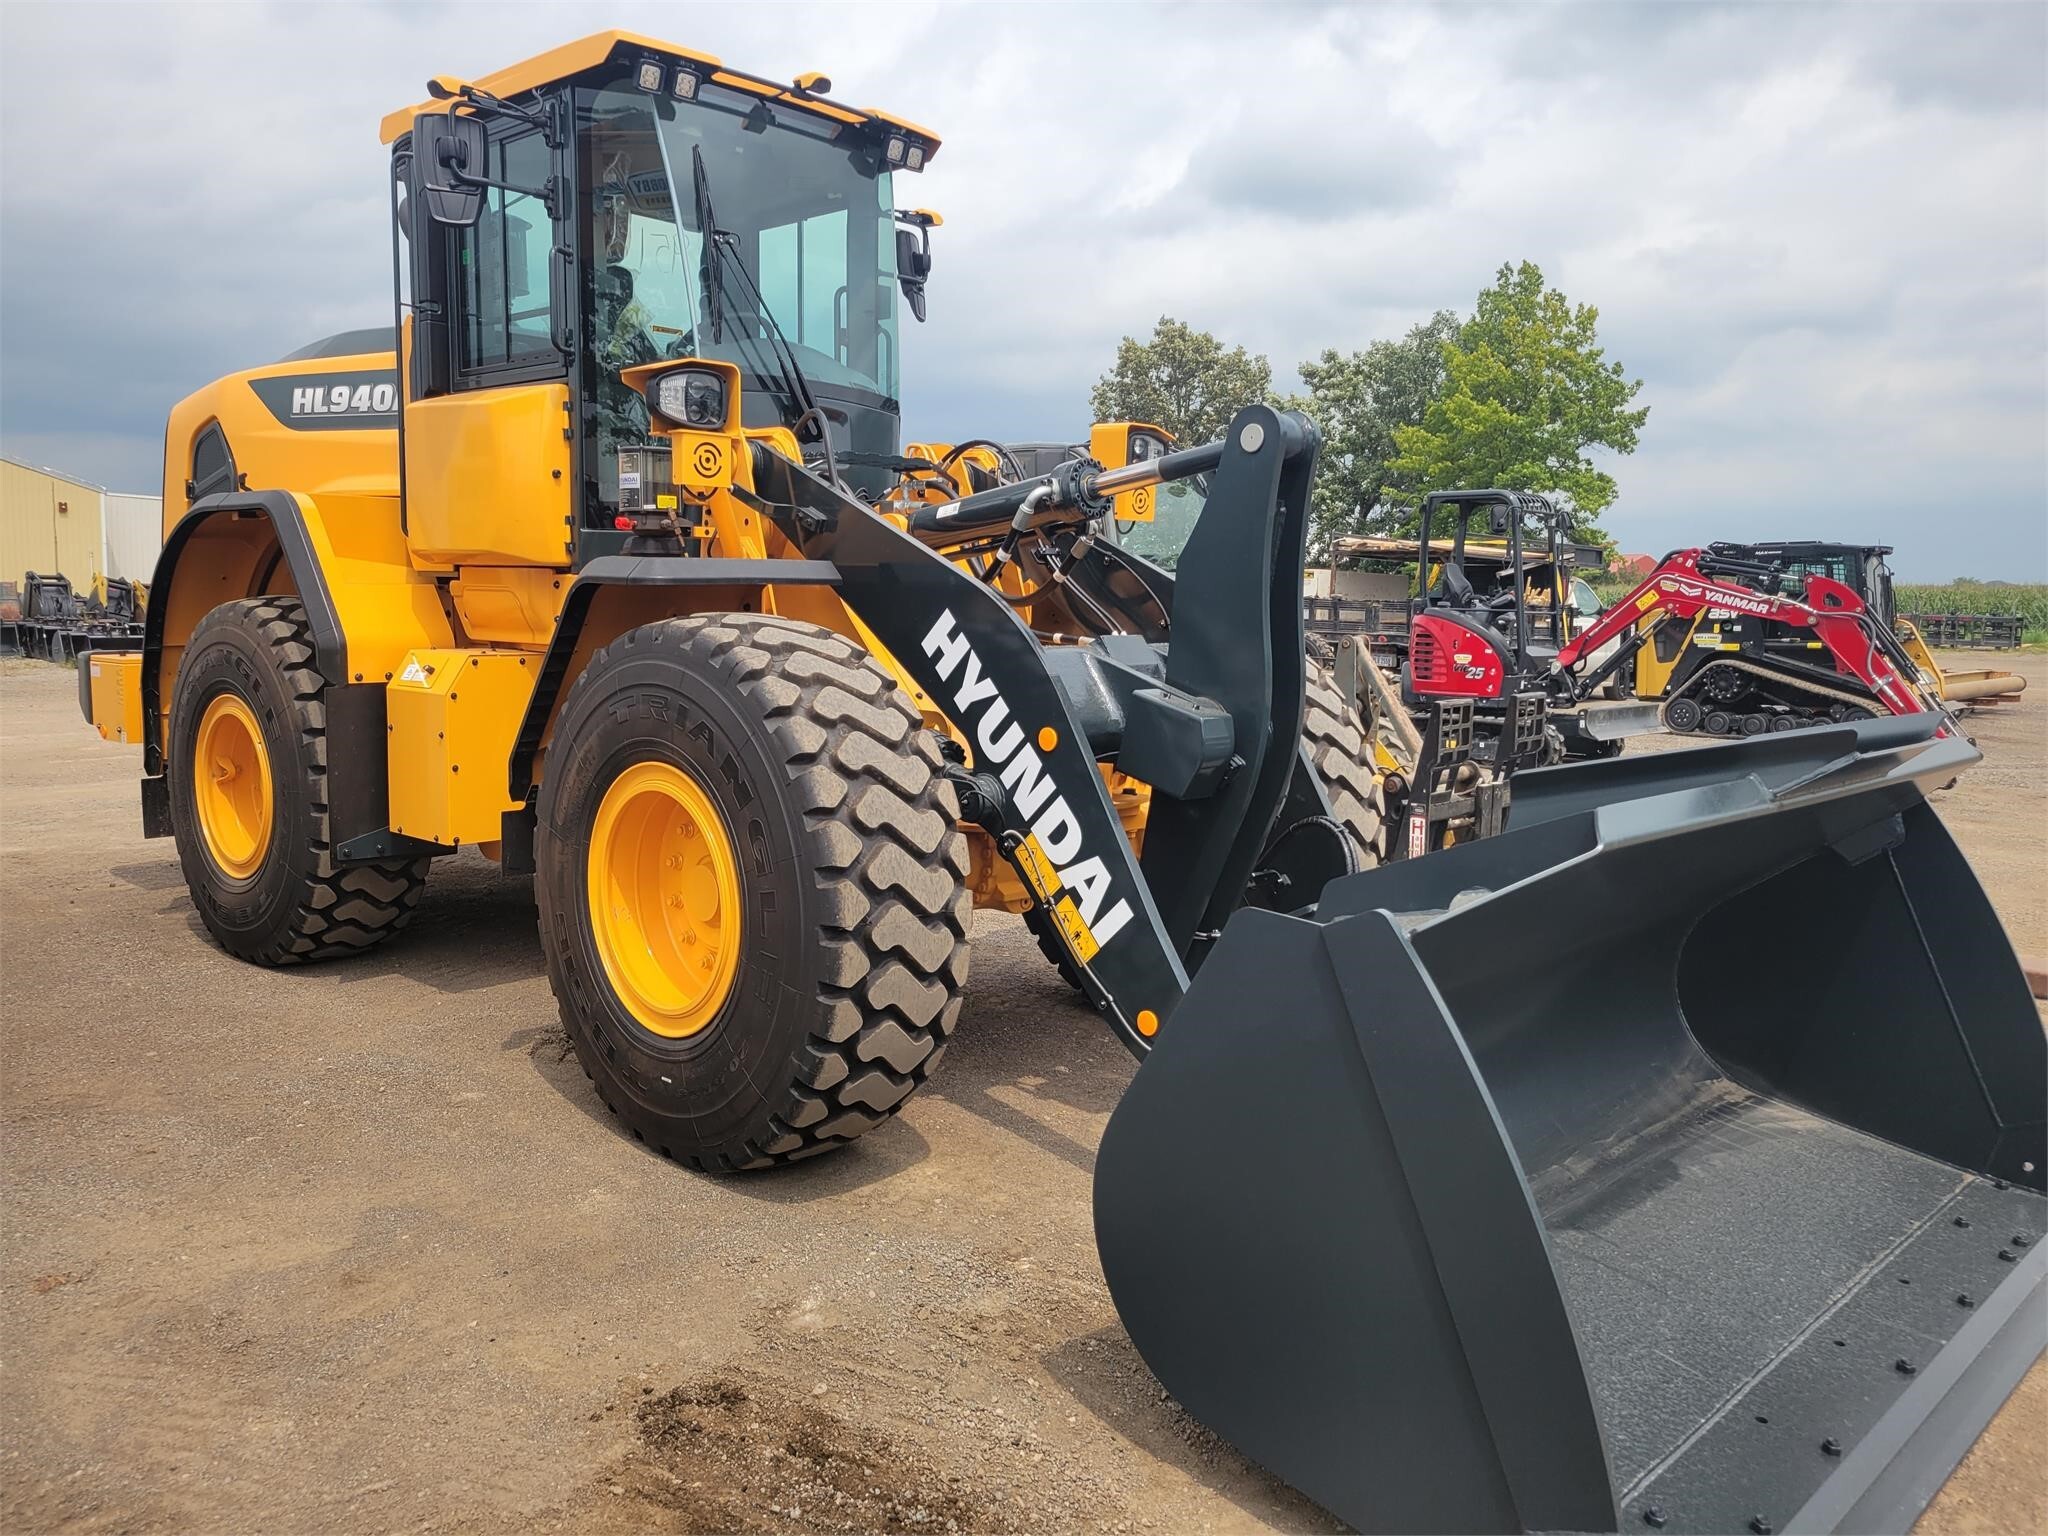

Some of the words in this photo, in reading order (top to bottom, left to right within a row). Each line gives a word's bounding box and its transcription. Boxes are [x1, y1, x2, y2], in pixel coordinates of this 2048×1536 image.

[1705, 590, 1769, 613] YANMAR
[608, 691, 778, 1016] TRIANGLE
[921, 608, 1134, 947] HYUNDAI
